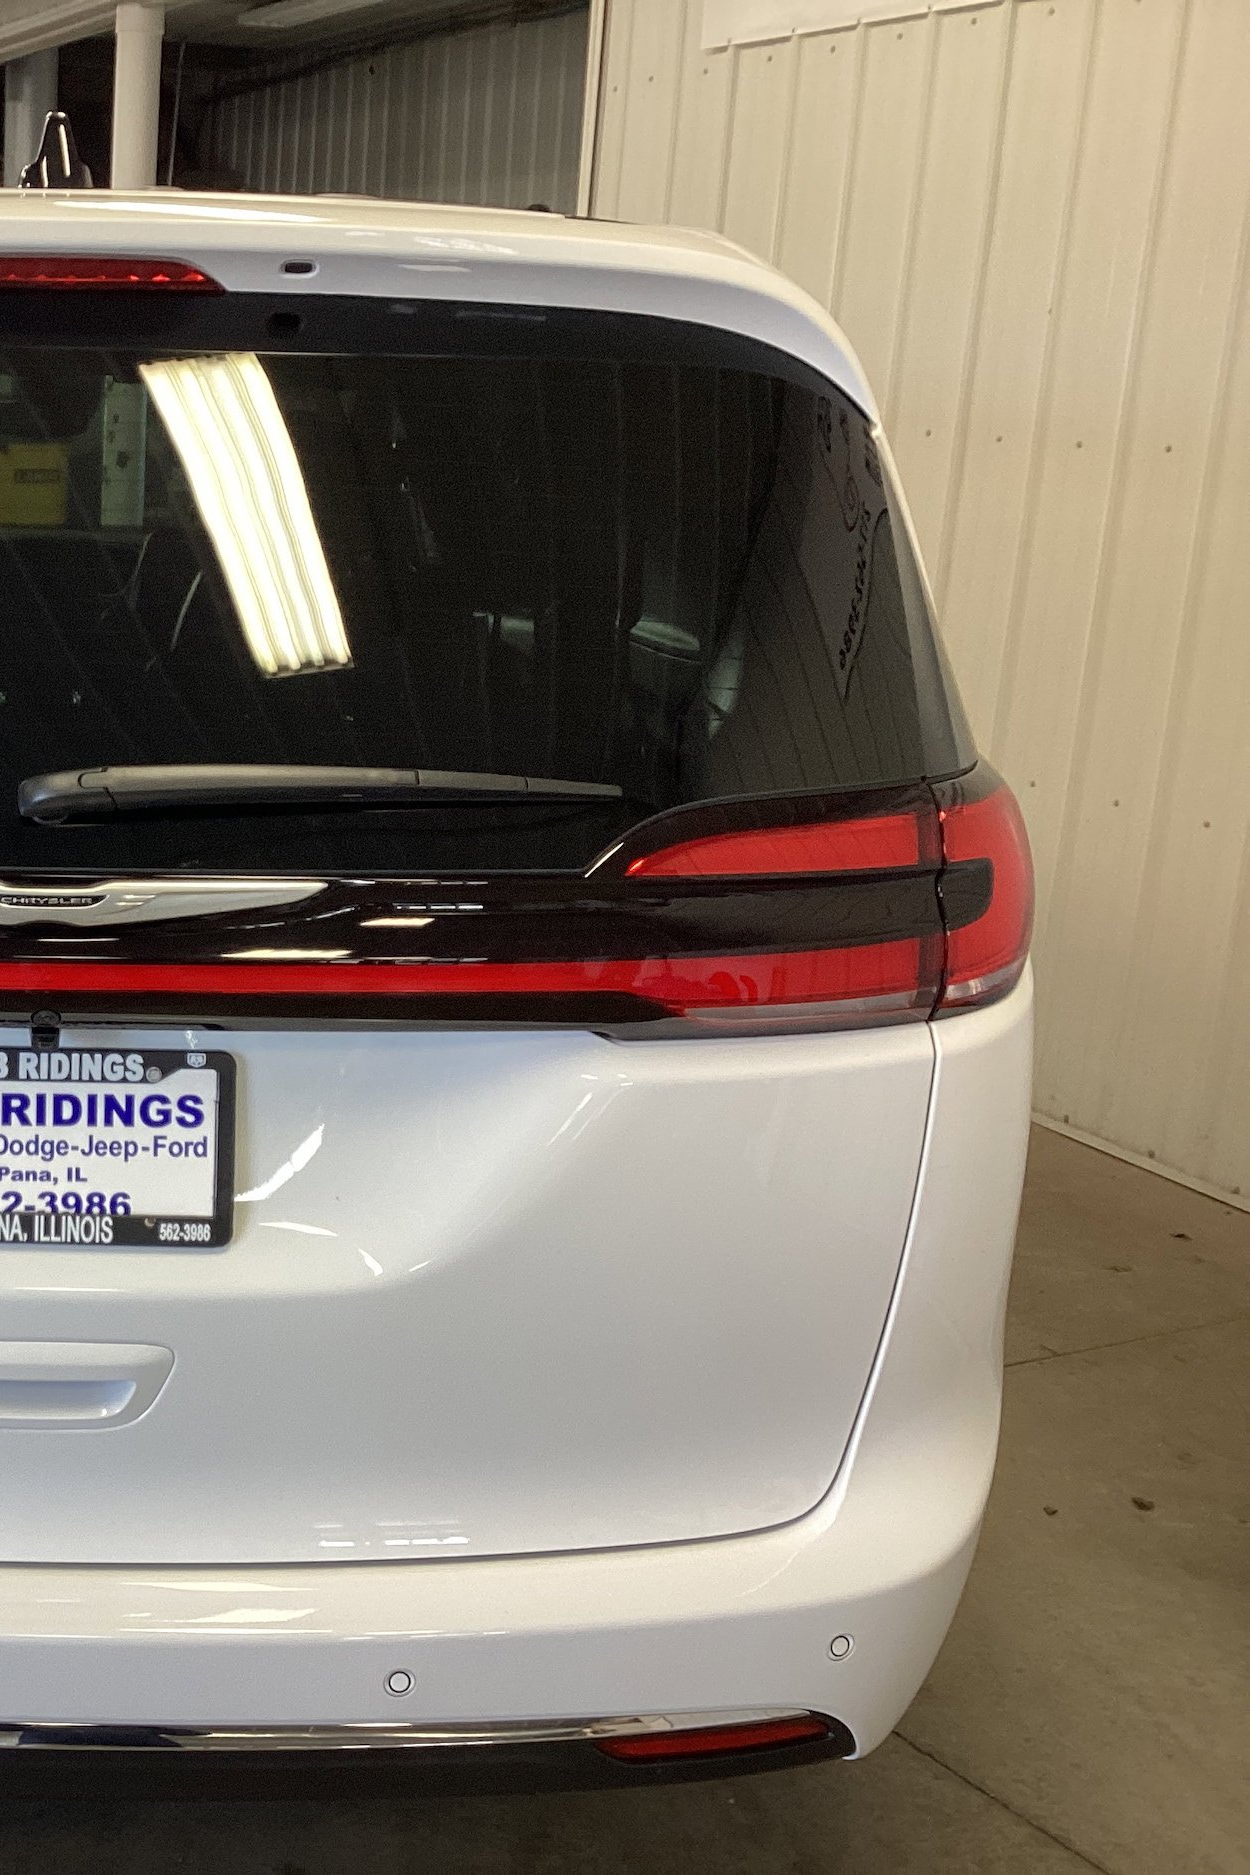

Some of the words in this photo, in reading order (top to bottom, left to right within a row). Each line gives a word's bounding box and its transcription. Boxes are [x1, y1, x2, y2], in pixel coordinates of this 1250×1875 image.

[1, 896, 92, 904] CHRYSLER
[17, 1052, 145, 1082] RIDINGS
[1, 1093, 205, 1128] RIDINGS
[66, 1167, 88, 1183] IL
[33, 1215, 114, 1244] ILLINOIS
[158, 1222, 211, 1242] 562-3986
